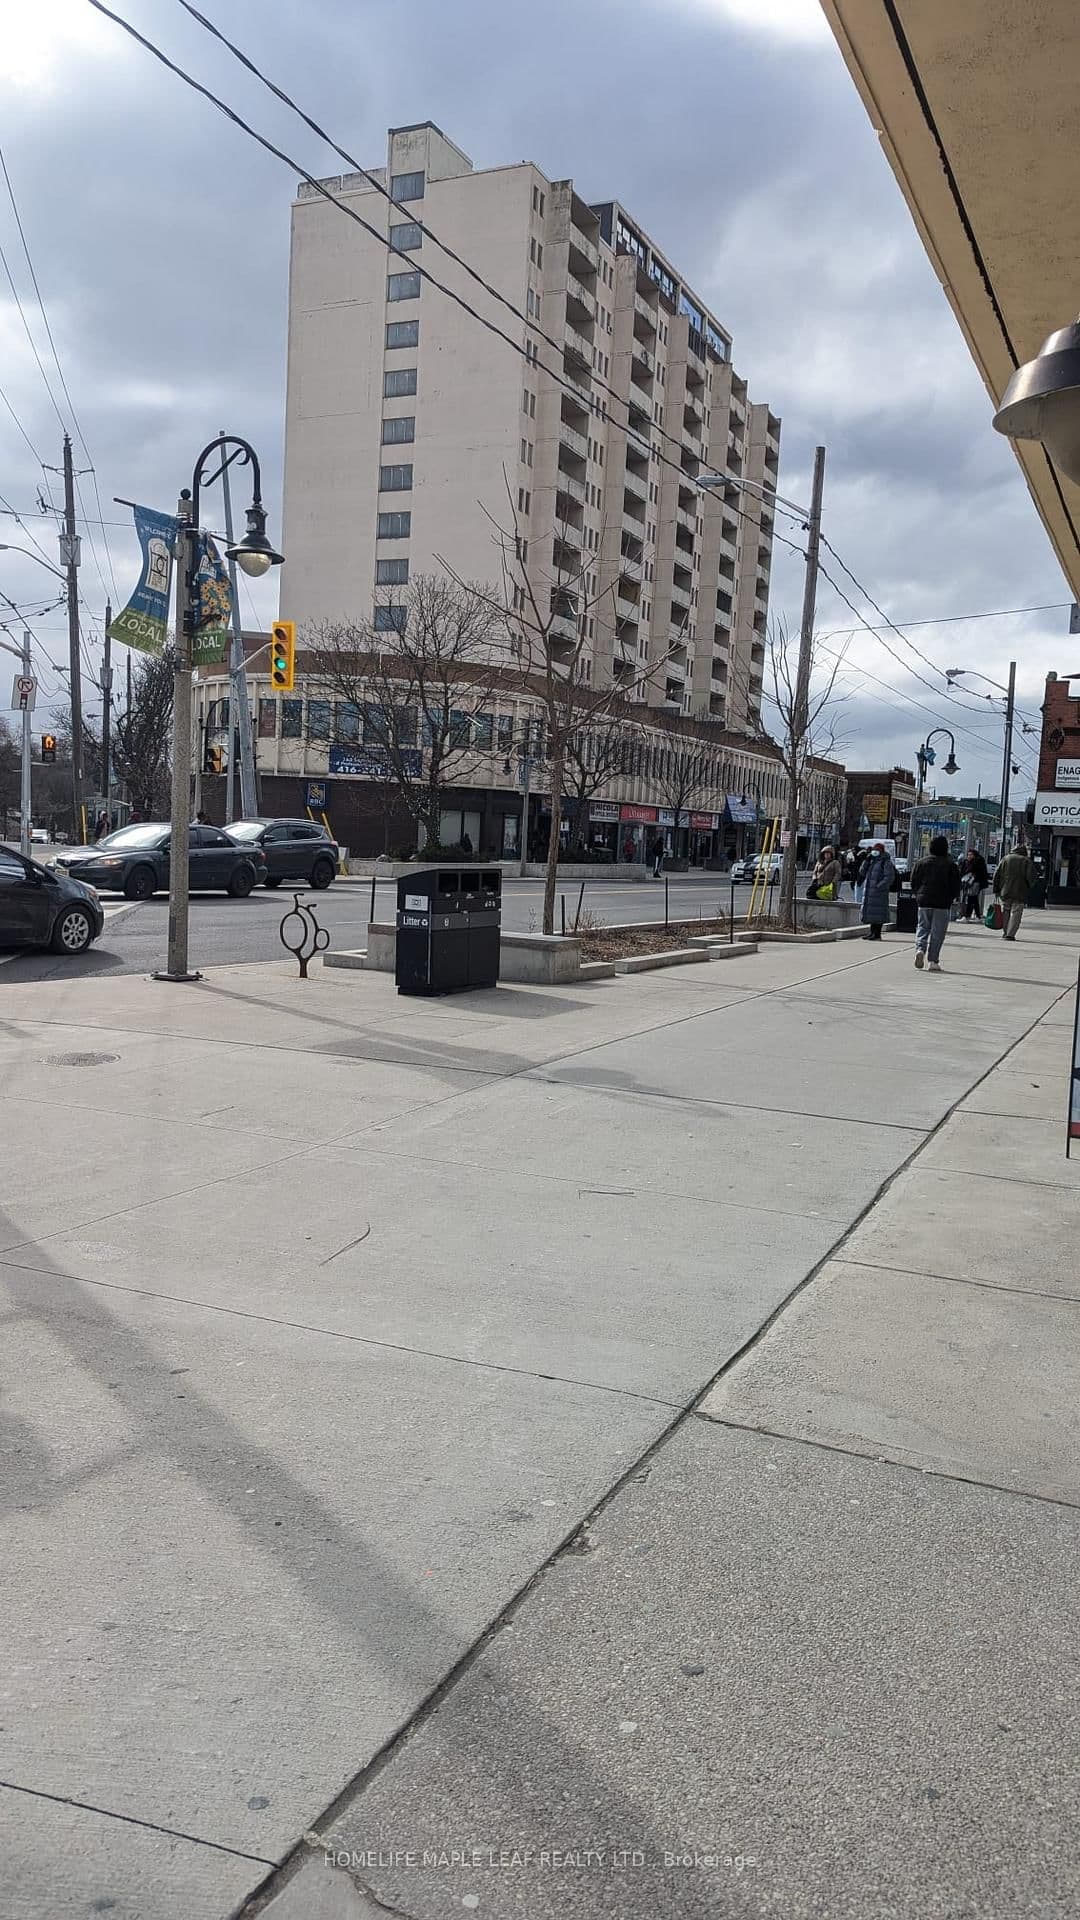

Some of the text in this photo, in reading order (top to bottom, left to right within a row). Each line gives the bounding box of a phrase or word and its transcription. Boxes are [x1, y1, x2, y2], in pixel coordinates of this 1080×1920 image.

[118, 615, 163, 643] LOCAL
[191, 635, 222, 651] LOCAL
[403, 915, 420, 926] Litter
